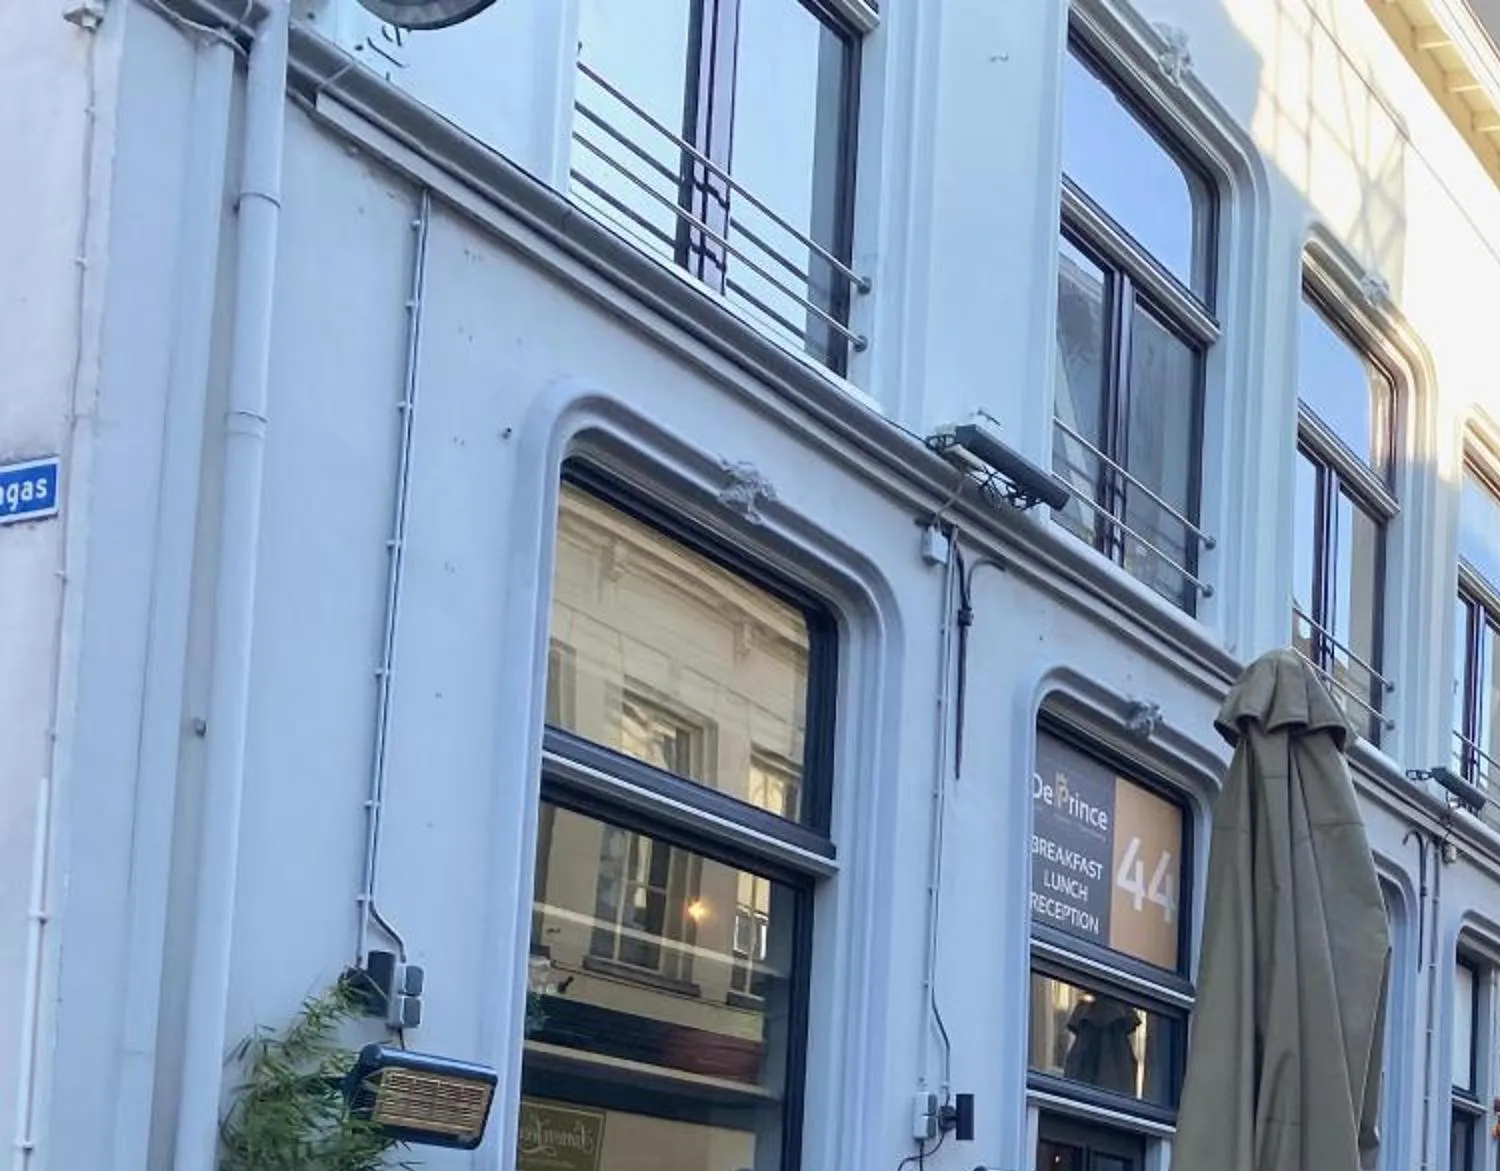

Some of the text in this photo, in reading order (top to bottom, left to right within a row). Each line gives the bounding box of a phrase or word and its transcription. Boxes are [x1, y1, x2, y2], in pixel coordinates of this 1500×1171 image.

[1032, 771, 1108, 831] De Prince
[1031, 834, 1104, 881] BREAKFAST
[1115, 836, 1176, 924] 44
[1043, 868, 1088, 903] LUNCH
[1030, 891, 1099, 935] RECEPTION
